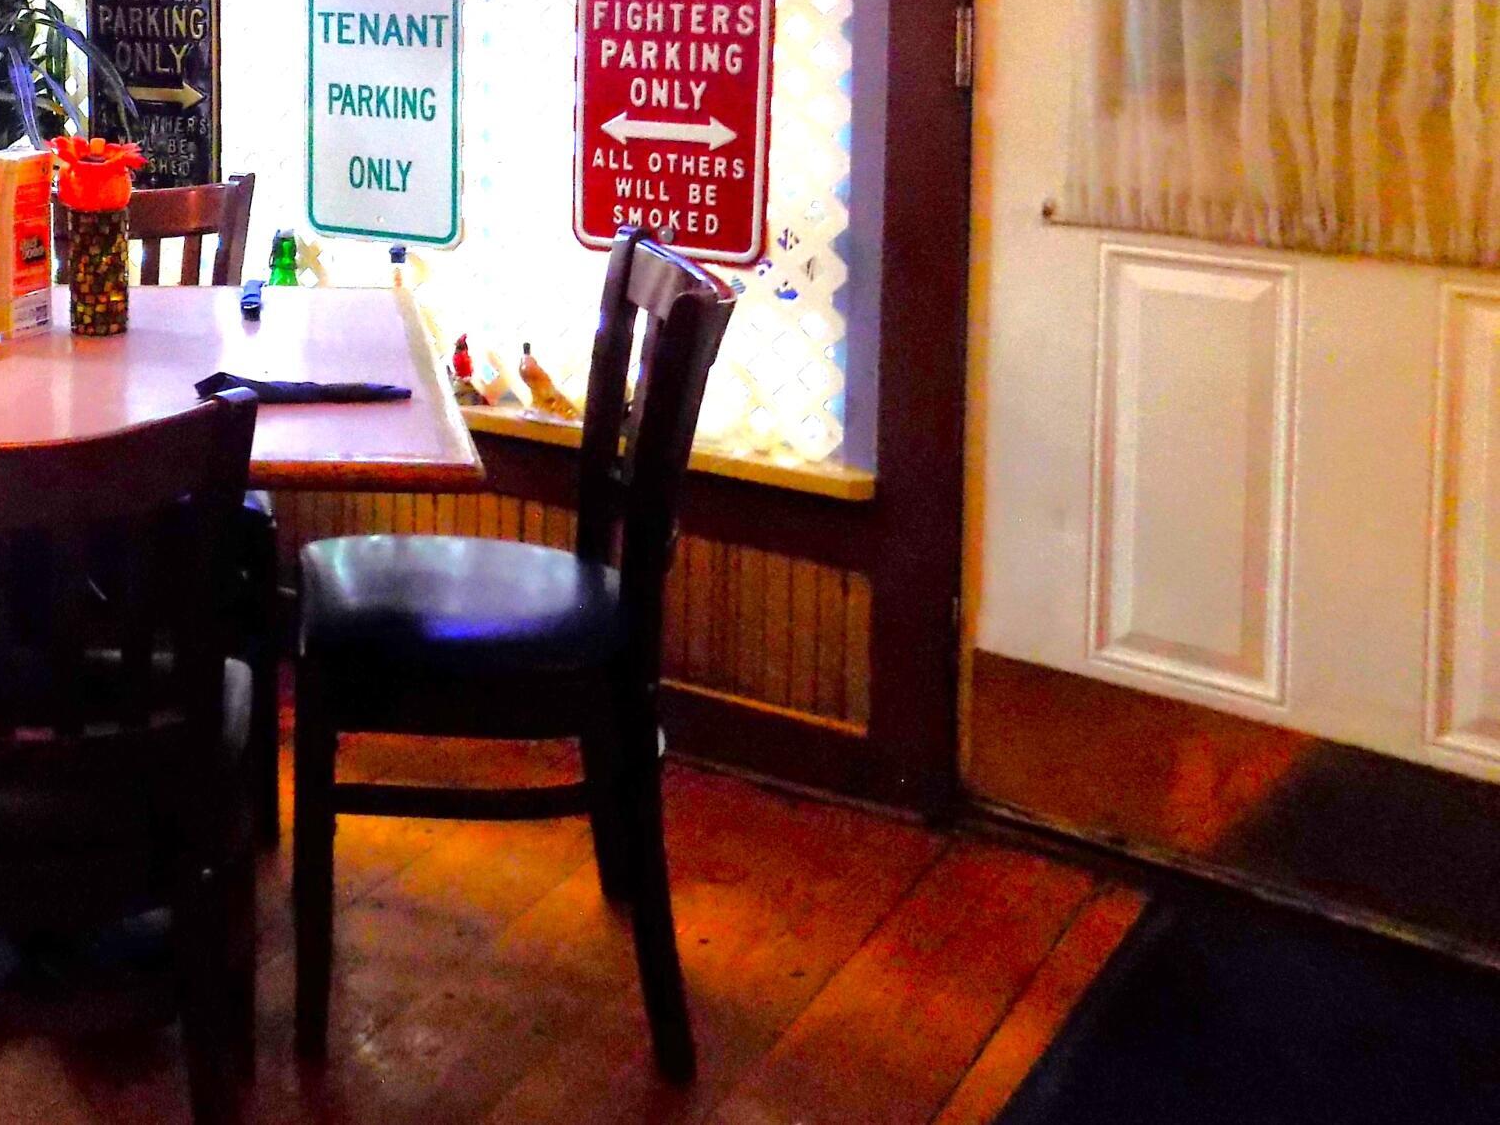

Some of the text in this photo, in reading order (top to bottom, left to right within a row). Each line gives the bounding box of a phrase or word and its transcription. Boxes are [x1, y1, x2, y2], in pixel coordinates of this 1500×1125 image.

[99, 5, 204, 39] PARKING
[318, 11, 450, 48] TENANT
[592, 1, 755, 36] FIGHTERS
[114, 41, 191, 74] ONLY
[600, 39, 744, 74] PARKING
[327, 83, 437, 122] PARKING
[629, 77, 708, 111] ONLY
[348, 155, 413, 193] ONLY
[592, 147, 746, 180] ALL OTHERS
[615, 177, 718, 206] WILL BE
[612, 205, 720, 235] SMOKED
